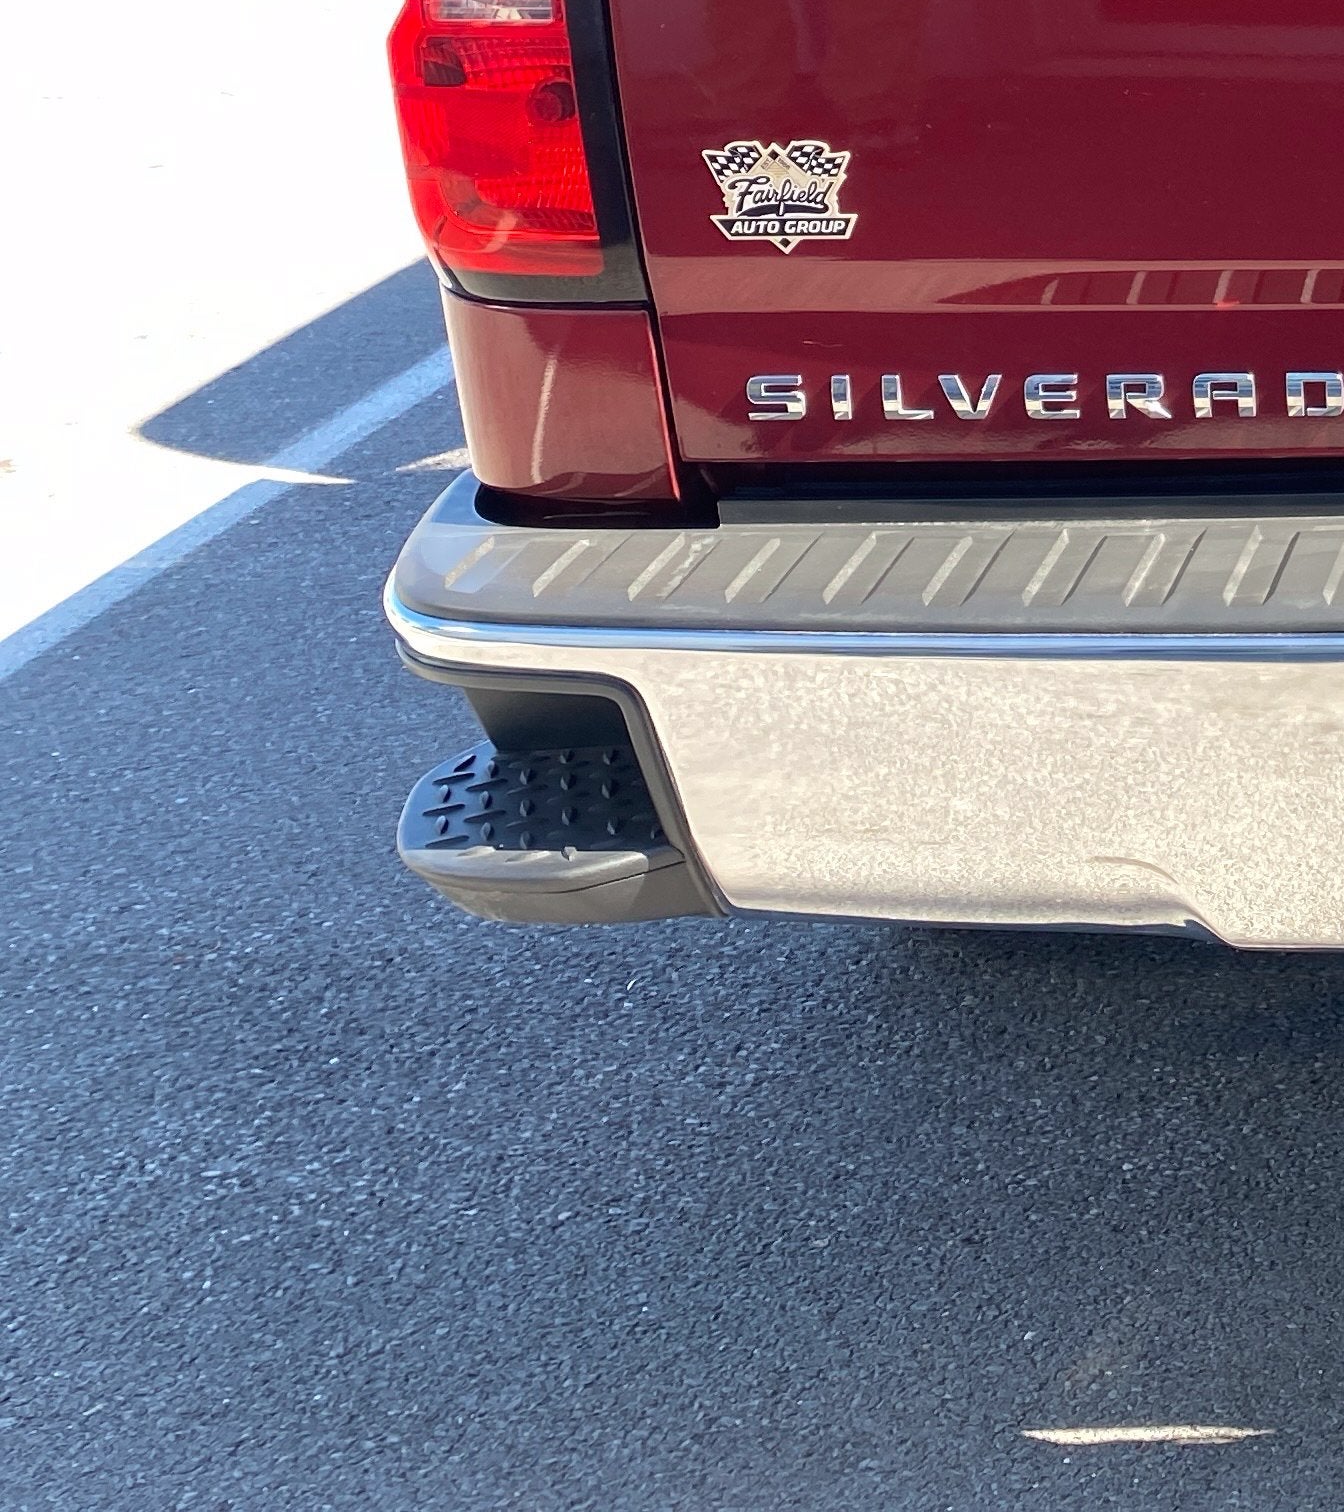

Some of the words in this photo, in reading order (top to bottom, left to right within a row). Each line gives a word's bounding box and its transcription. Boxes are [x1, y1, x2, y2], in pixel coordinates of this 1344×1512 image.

[727, 175, 835, 214] Fairfield
[730, 220, 781, 234] AUTO
[784, 220, 846, 234] GROUP
